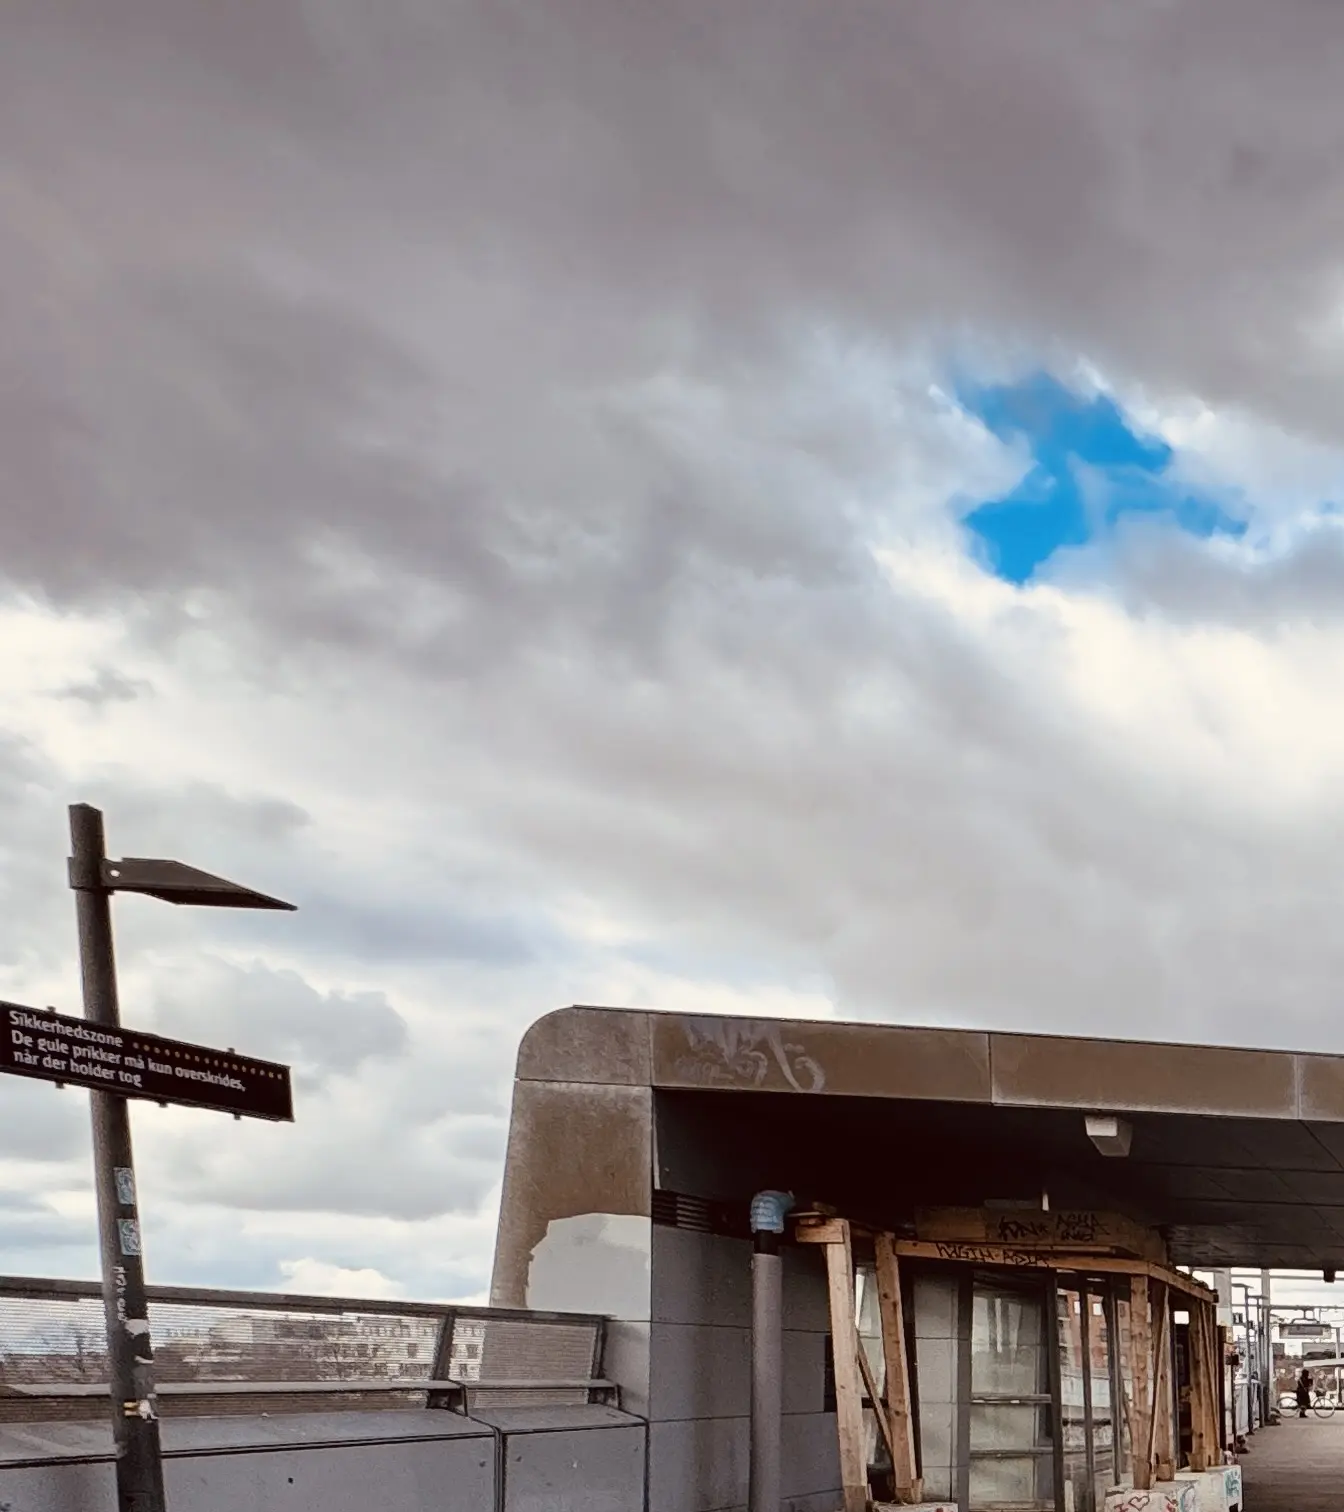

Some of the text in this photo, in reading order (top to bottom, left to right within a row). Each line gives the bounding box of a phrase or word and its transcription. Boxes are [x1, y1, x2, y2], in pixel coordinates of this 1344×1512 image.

[9, 1010, 123, 1047] Sikkerhedszone
[11, 1029, 246, 1092] De gule prikker må kun overskrides,
[13, 1048, 142, 1088] når der holder tog
